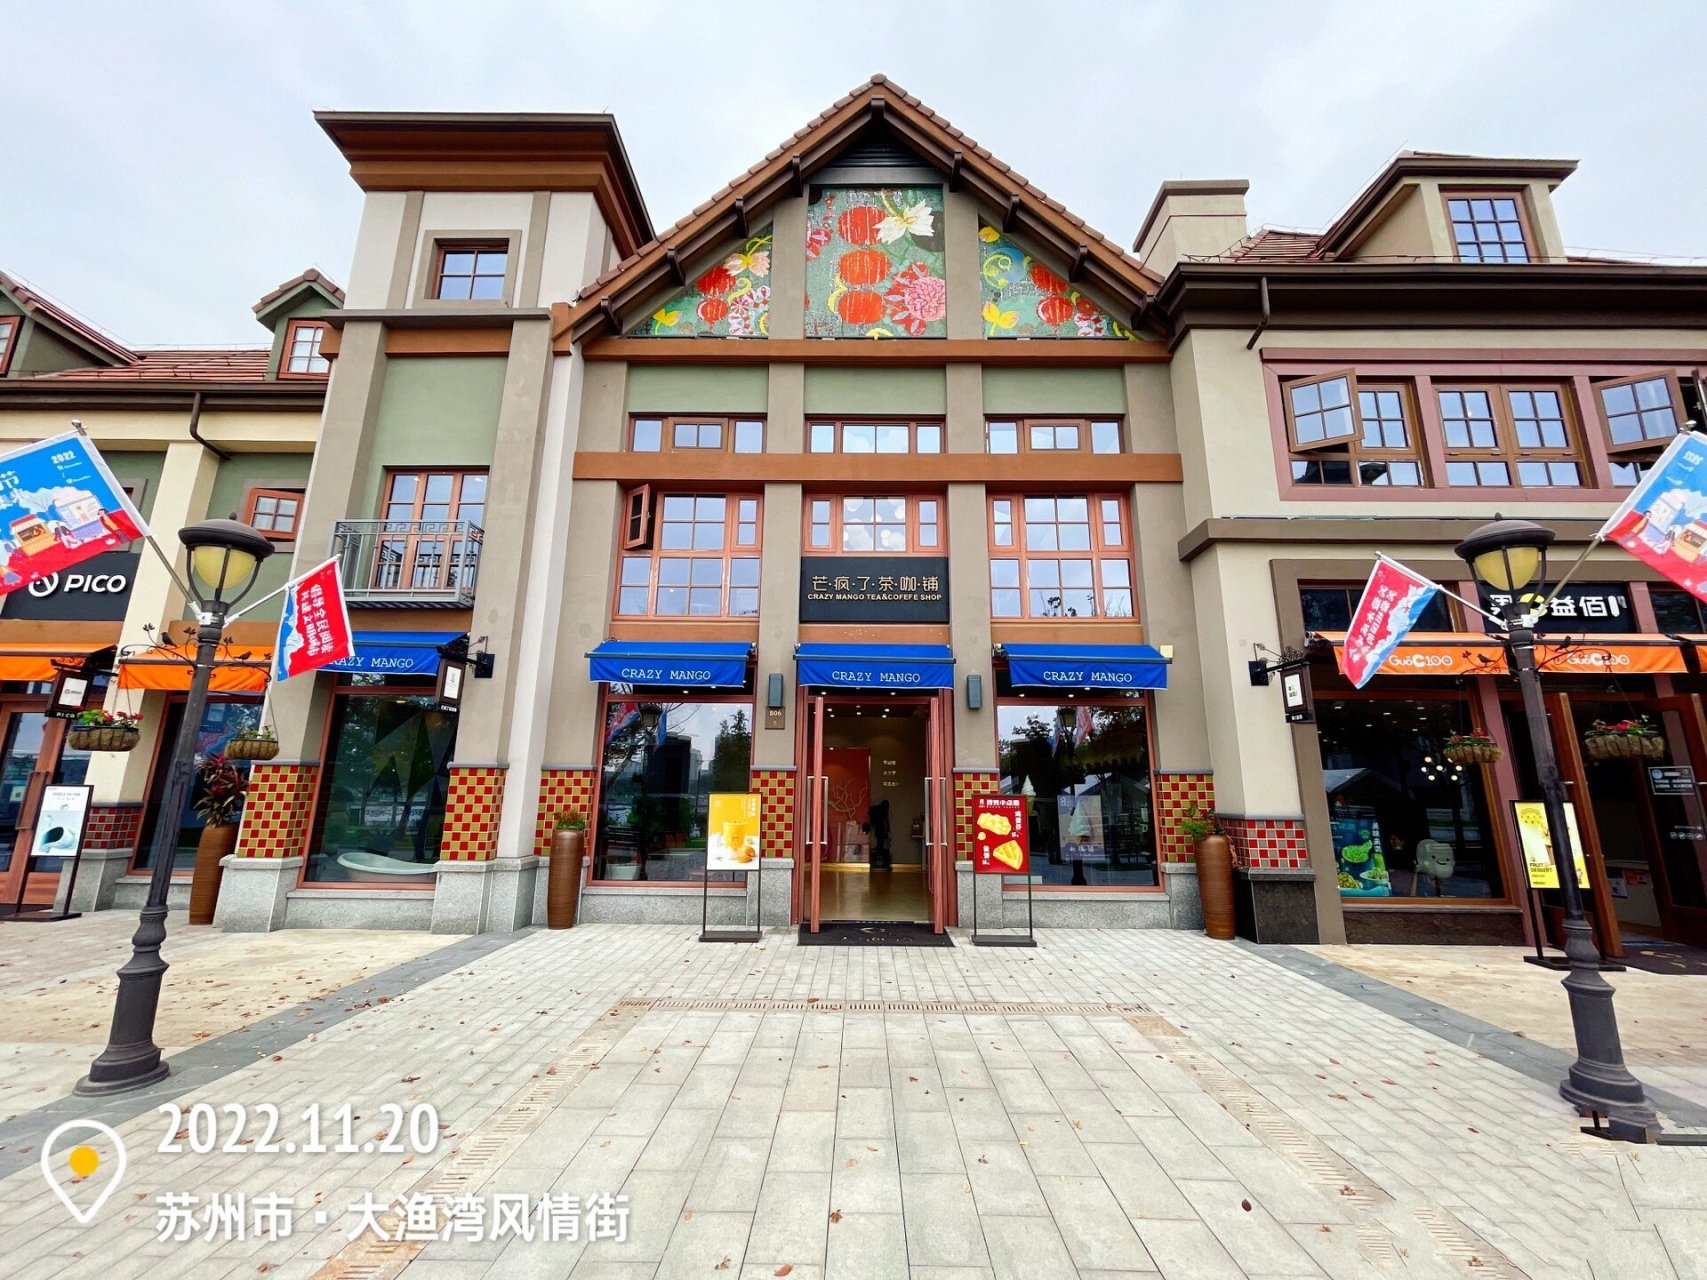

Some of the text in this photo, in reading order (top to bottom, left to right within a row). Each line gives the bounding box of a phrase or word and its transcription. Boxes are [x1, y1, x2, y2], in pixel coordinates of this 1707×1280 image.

[51, 450, 77, 464] 2022
[64, 574, 126, 593] PICO
[371, 658, 413, 668] MANGO
[621, 668, 711, 680] CRAZY MANGO
[831, 670, 921, 682] CRAZY MANGO
[1043, 671, 1132, 682] CRAZY MANGO
